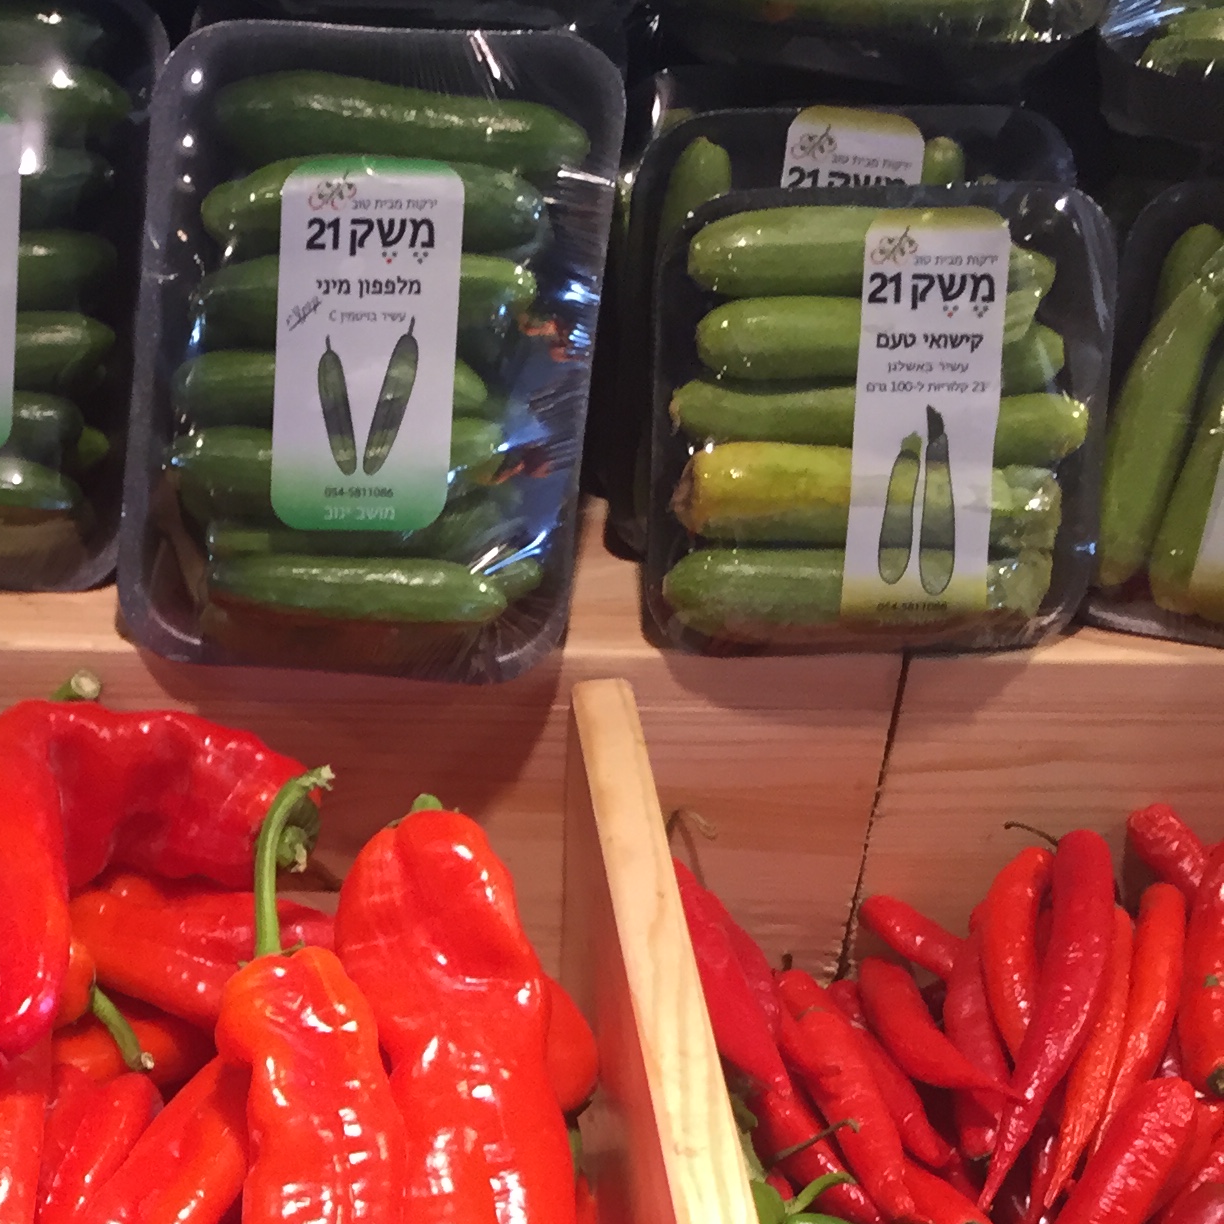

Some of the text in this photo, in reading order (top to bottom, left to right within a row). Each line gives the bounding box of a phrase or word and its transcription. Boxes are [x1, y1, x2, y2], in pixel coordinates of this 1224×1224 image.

[788, 166, 820, 188] 21
[306, 217, 341, 250] 21
[316, 276, 422, 298] מלפפון מיני
[867, 272, 902, 304] 21
[329, 310, 337, 321] C
[876, 332, 984, 353] קישואי טעם
